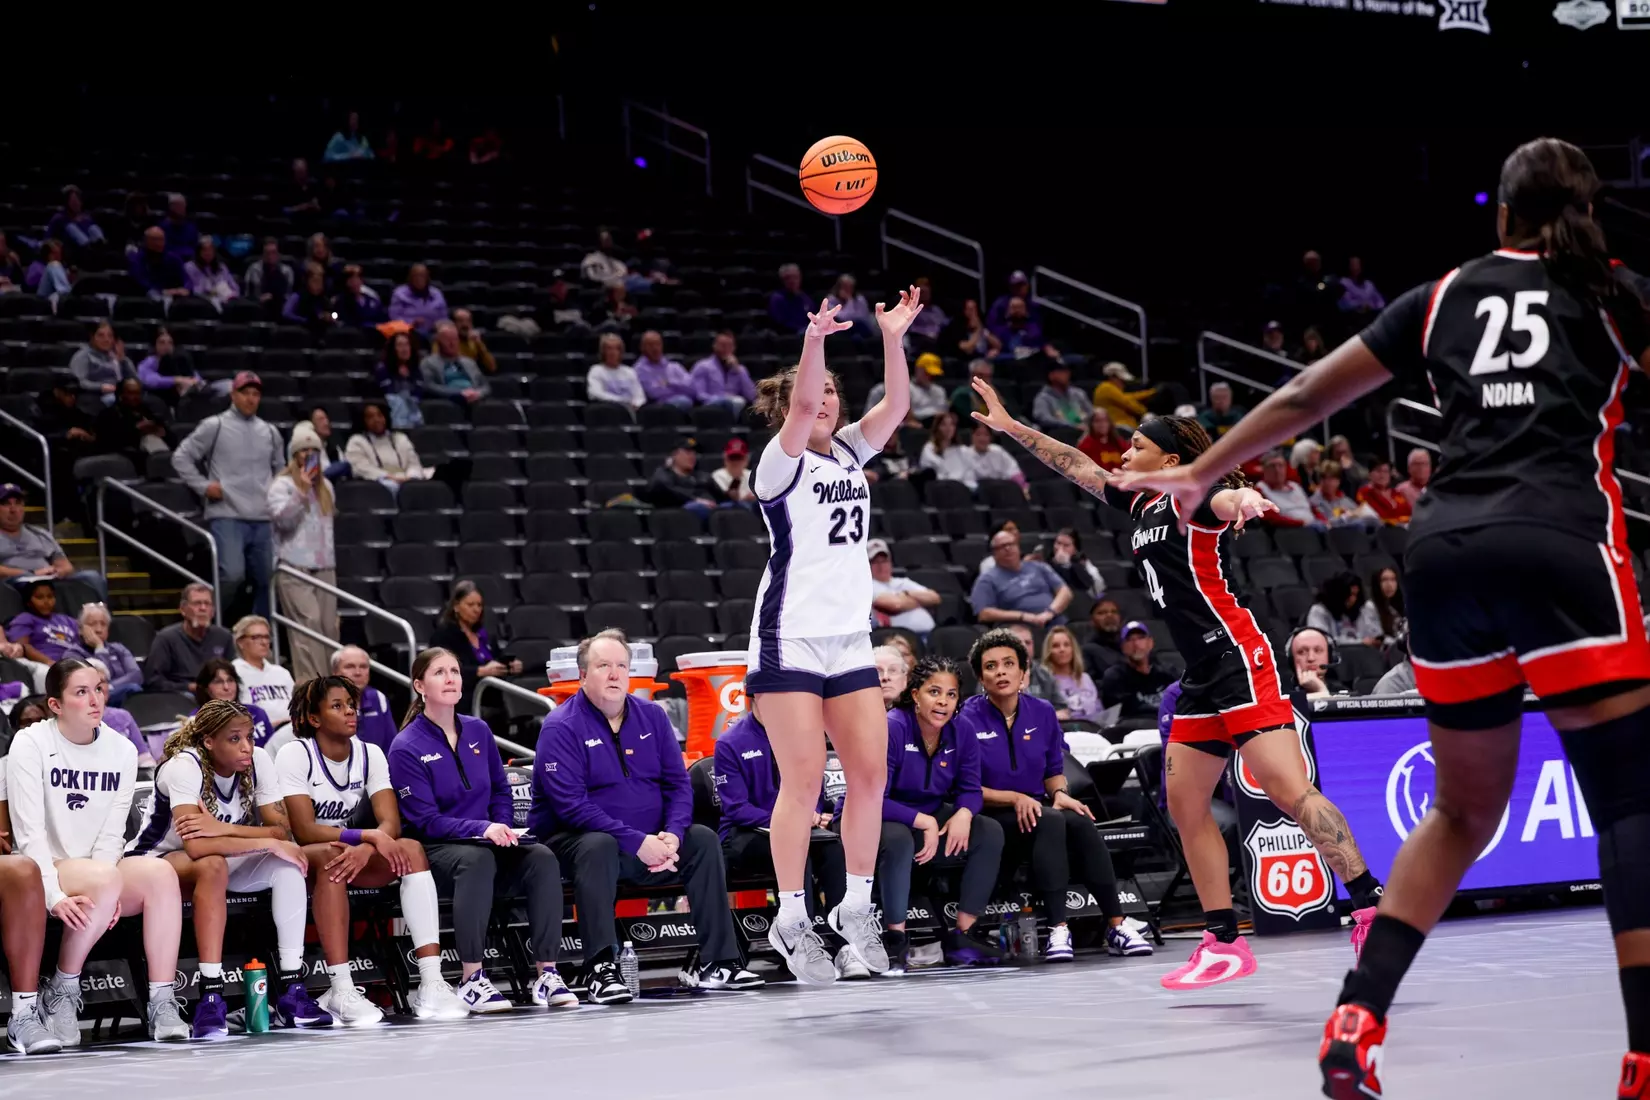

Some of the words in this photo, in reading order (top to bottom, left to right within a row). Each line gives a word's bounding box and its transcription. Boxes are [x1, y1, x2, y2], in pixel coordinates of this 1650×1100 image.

[821, 150, 871, 168] Wilson
[1468, 290, 1550, 376] 25
[1482, 381, 1535, 409] NDIBA
[828, 506, 863, 546] 23
[1142, 558, 1166, 609] 4
[720, 681, 747, 712] G
[83, 771, 99, 791] IT
[101, 772, 121, 791] IN
[1104, 832, 1145, 840] CONFERENCE
[1267, 859, 1314, 897] 66
[986, 901, 1021, 915] state
